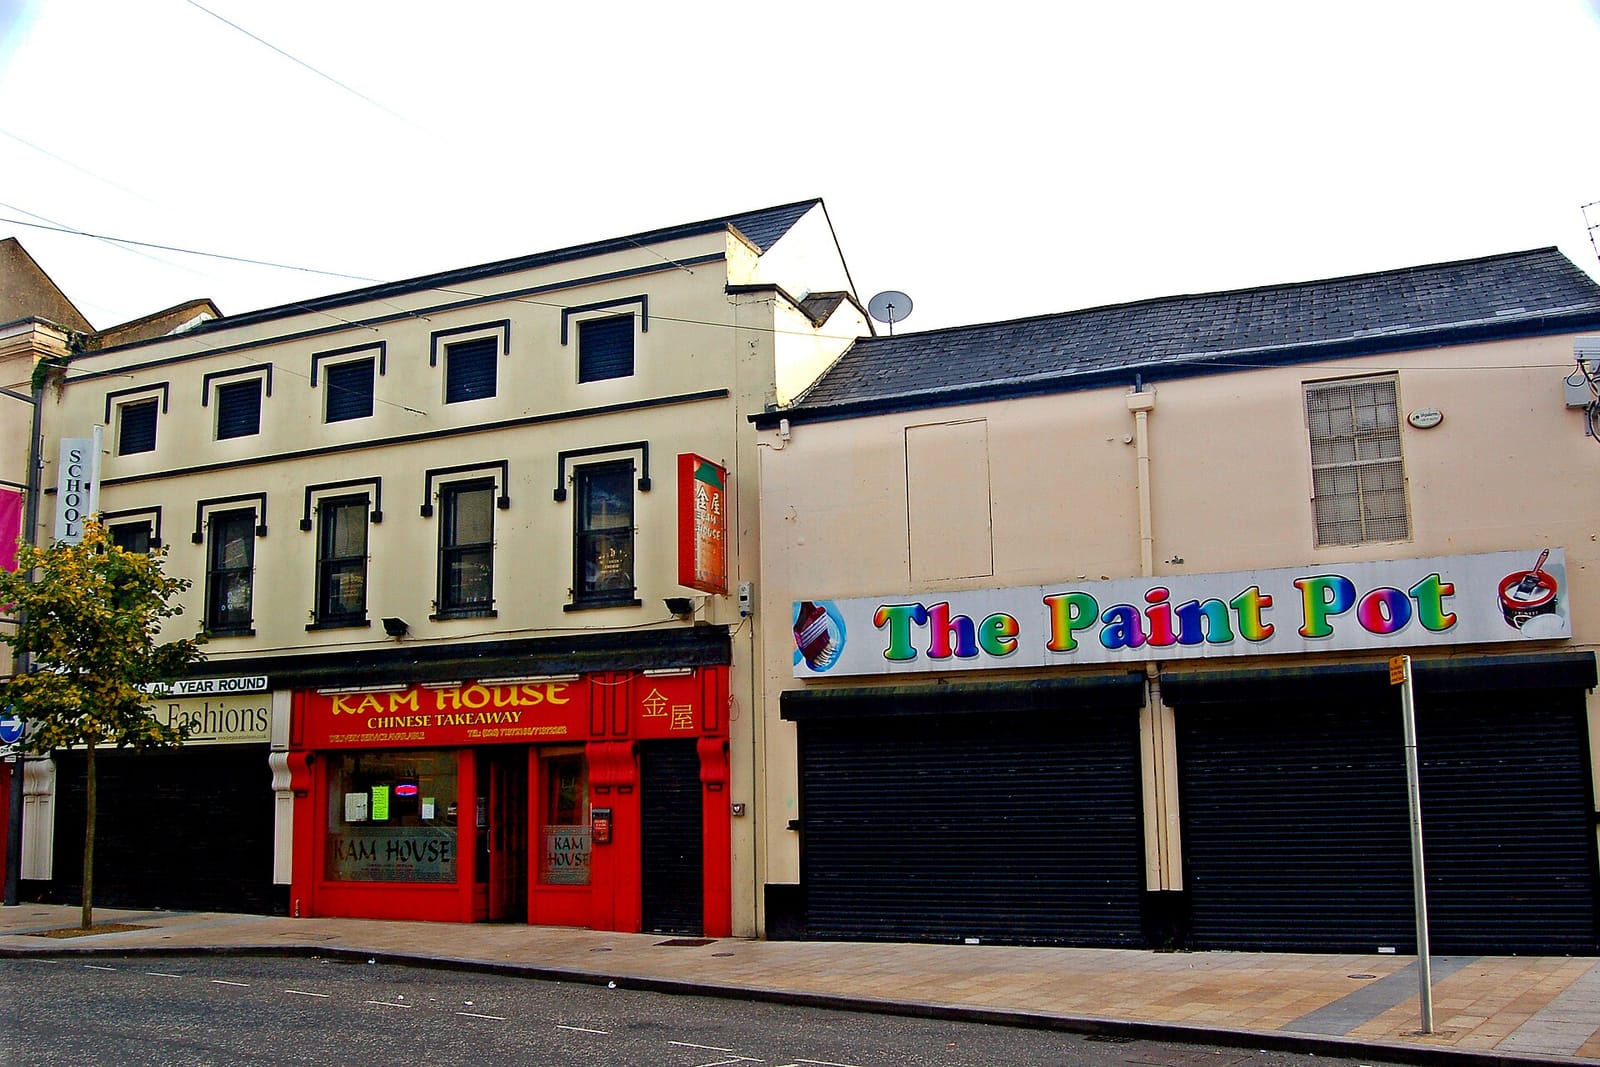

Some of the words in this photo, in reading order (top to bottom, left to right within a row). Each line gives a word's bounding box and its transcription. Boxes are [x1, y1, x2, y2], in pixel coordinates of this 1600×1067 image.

[65, 449, 81, 537] SCHOOL
[874, 602, 1020, 660] The
[1043, 587, 1275, 652] Paint
[1293, 573, 1457, 638] Pot
[180, 681, 214, 693] YEAR
[218, 677, 266, 691] ROUND
[332, 689, 420, 716] KAM
[436, 682, 570, 711] HOUSE
[642, 688, 694, 731] 金屋
[168, 702, 267, 734] Fashions
[367, 714, 431, 730] CHINESE
[434, 711, 522, 726] TAKEAWAY
[334, 840, 377, 861] KAM
[386, 840, 450, 862] HOUSE
[554, 837, 583, 850] KAM
[549, 853, 589, 866] HOUSE
